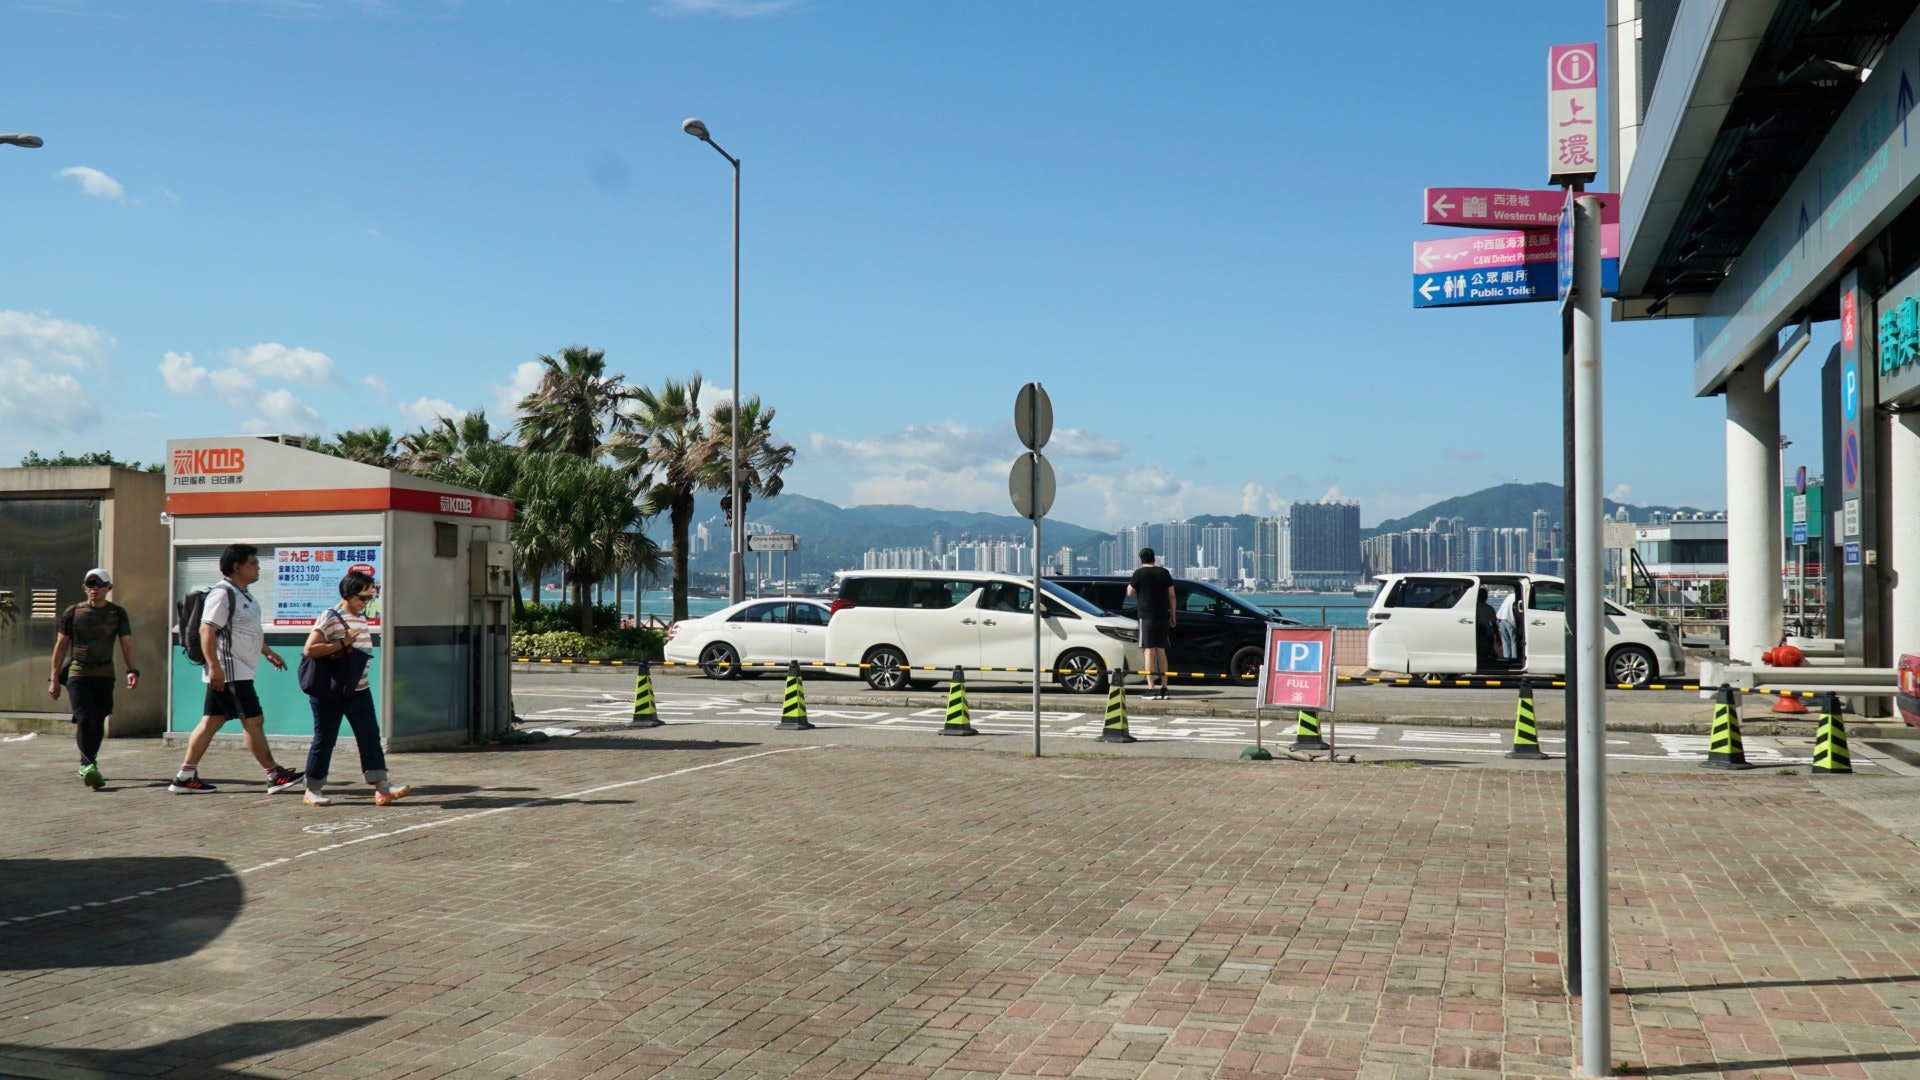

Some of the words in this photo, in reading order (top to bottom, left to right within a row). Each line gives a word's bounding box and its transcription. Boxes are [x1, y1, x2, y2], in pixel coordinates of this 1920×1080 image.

[1559, 98, 1594, 165] 上環
[1494, 194, 1530, 206] 西港城
[1494, 211, 1536, 221] Western
[1474, 256, 1491, 265] C&W
[1470, 287, 1504, 297] Public
[1507, 285, 1536, 295] Toilet
[1878, 289, 1920, 377] 港澳
[1847, 370, 1855, 411] P
[194, 447, 245, 474] KMB
[449, 496, 473, 514] KMB
[1290, 643, 1309, 670] P
[1286, 679, 1310, 688] FULL
